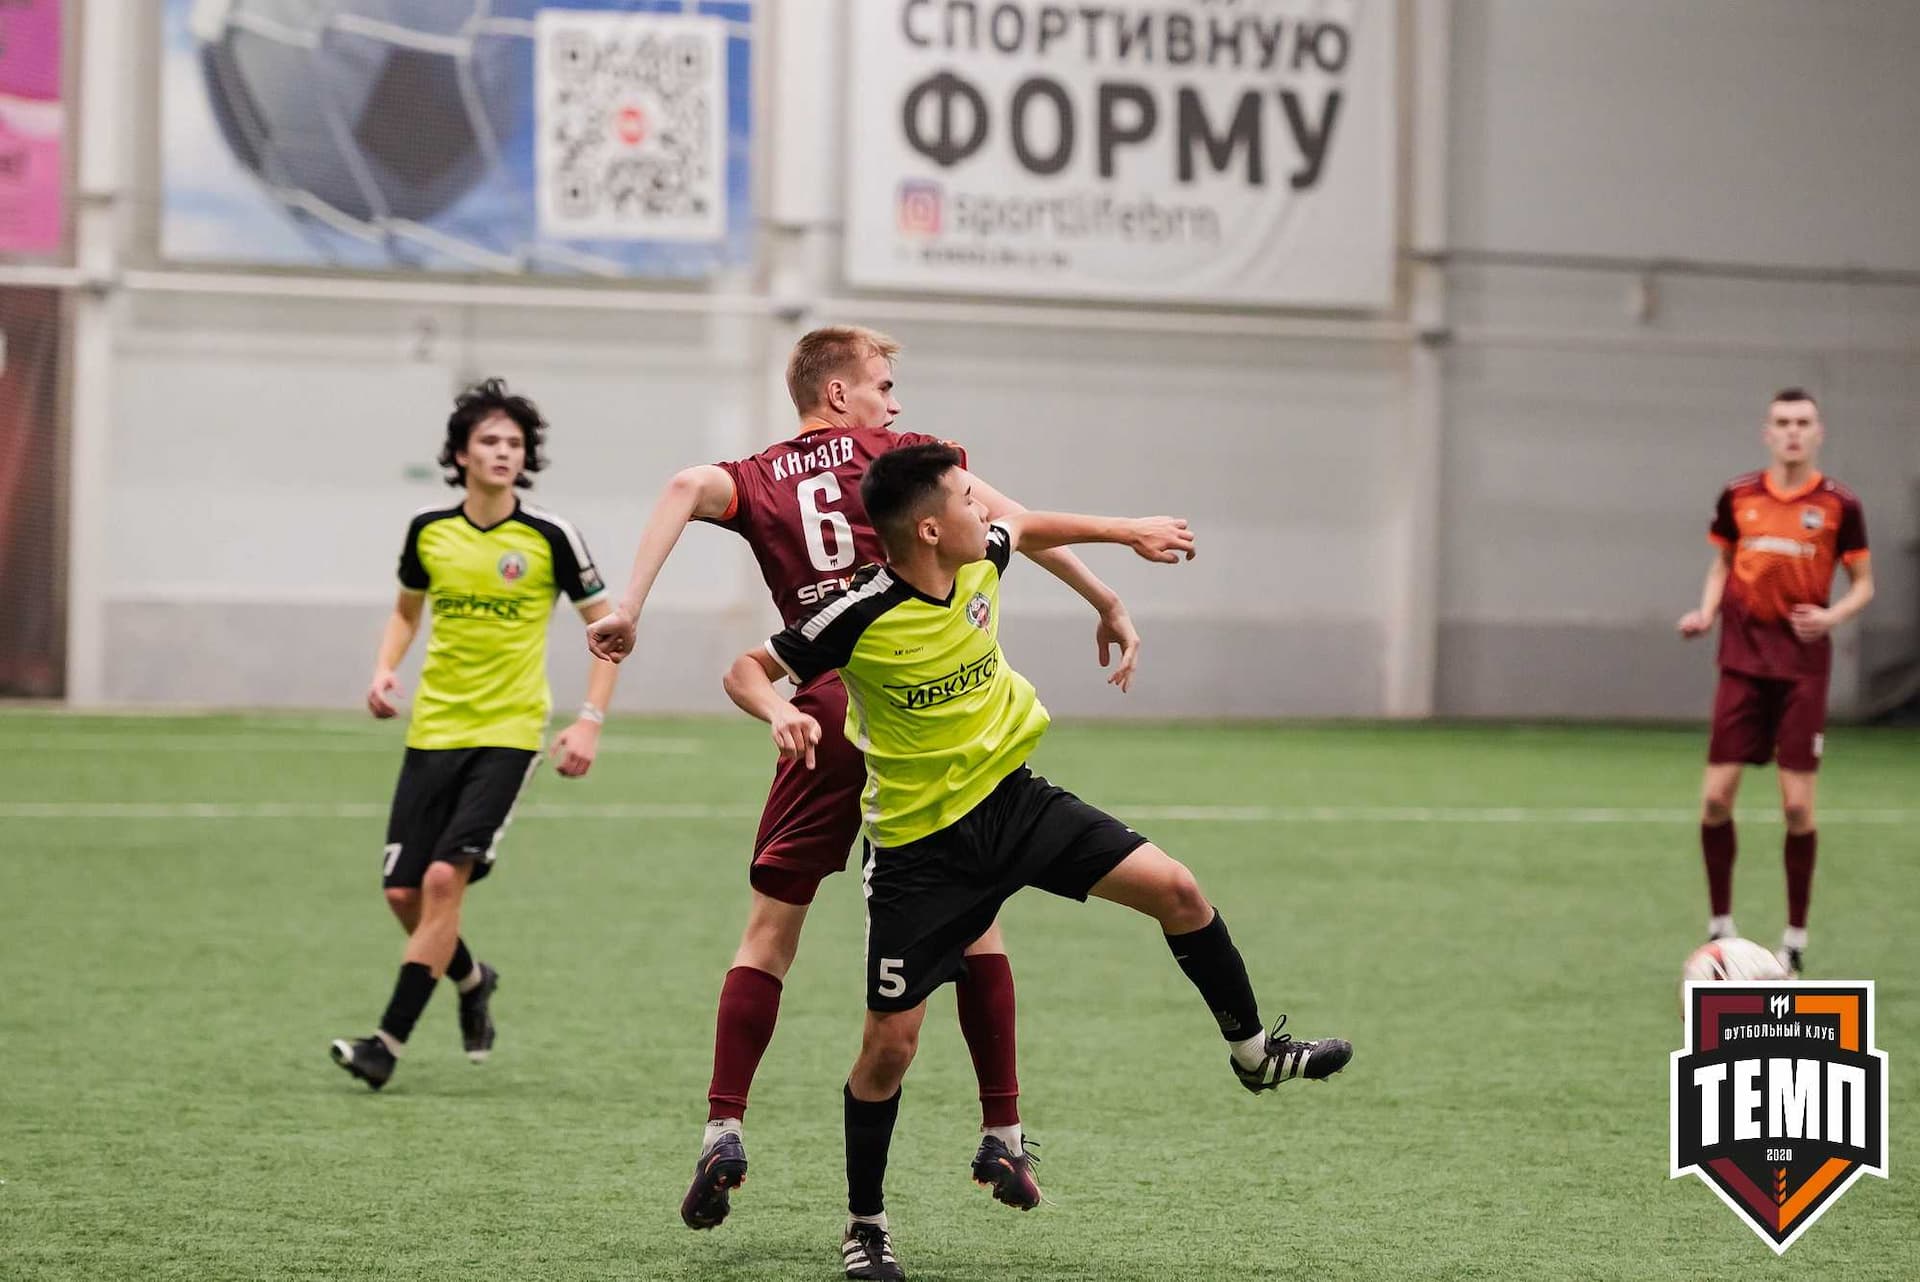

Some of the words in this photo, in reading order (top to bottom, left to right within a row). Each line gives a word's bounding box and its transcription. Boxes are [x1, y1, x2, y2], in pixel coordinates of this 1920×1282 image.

[902, 0, 1351, 73] СПОРТИВНУЮ
[902, 69, 1342, 190] ФОРМУ
[796, 471, 856, 572] 6
[878, 958, 906, 998] 5
